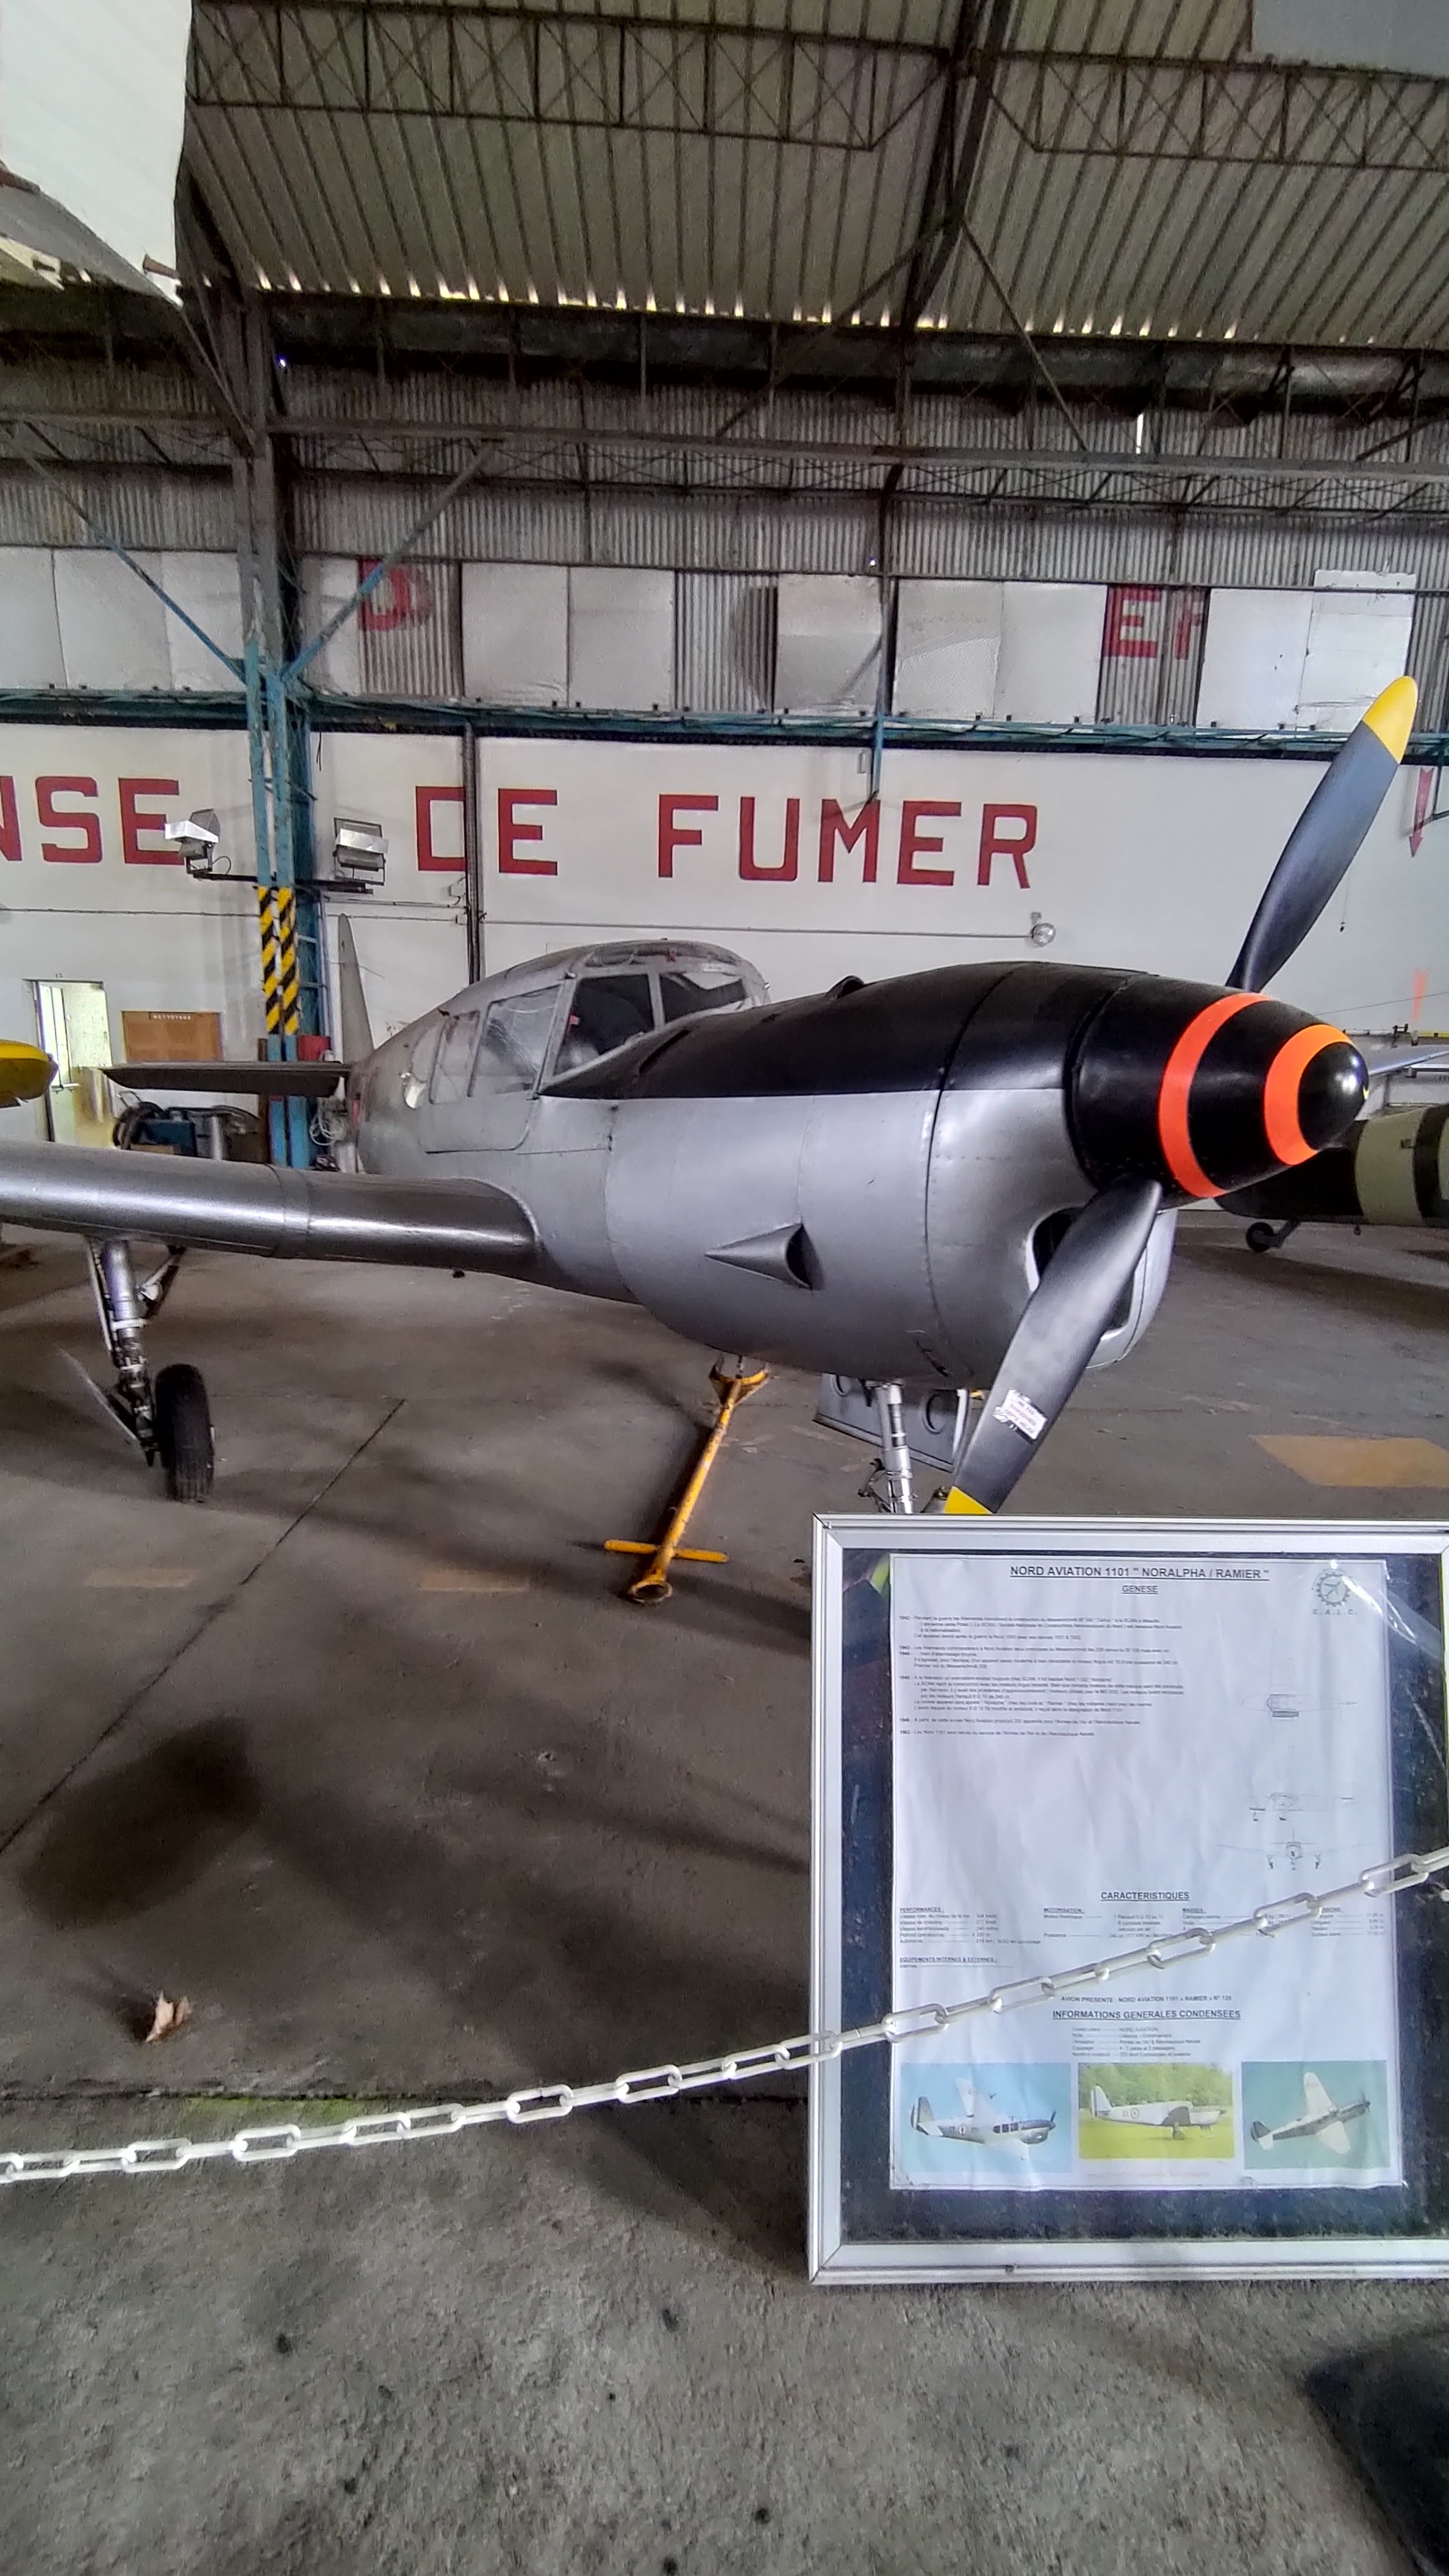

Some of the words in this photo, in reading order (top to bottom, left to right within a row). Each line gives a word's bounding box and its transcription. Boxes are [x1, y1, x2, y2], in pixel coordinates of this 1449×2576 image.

[658, 793, 1037, 889] FUMER
[1011, 1566, 1043, 1576] NORD
[1048, 1567, 1101, 1576] AVIATION
[1105, 1567, 1129, 1577] 1101
[1142, 1568, 1204, 1578] NORALPHA
[1217, 1569, 1261, 1579] RAMIER
[1122, 1585, 1158, 1594] GENESE
[1101, 1891, 1190, 1900] CARACTERISTIQUES
[1053, 2010, 1121, 2019] INFORMATIONS
[1179, 2009, 1241, 2018] CONDENSEES
